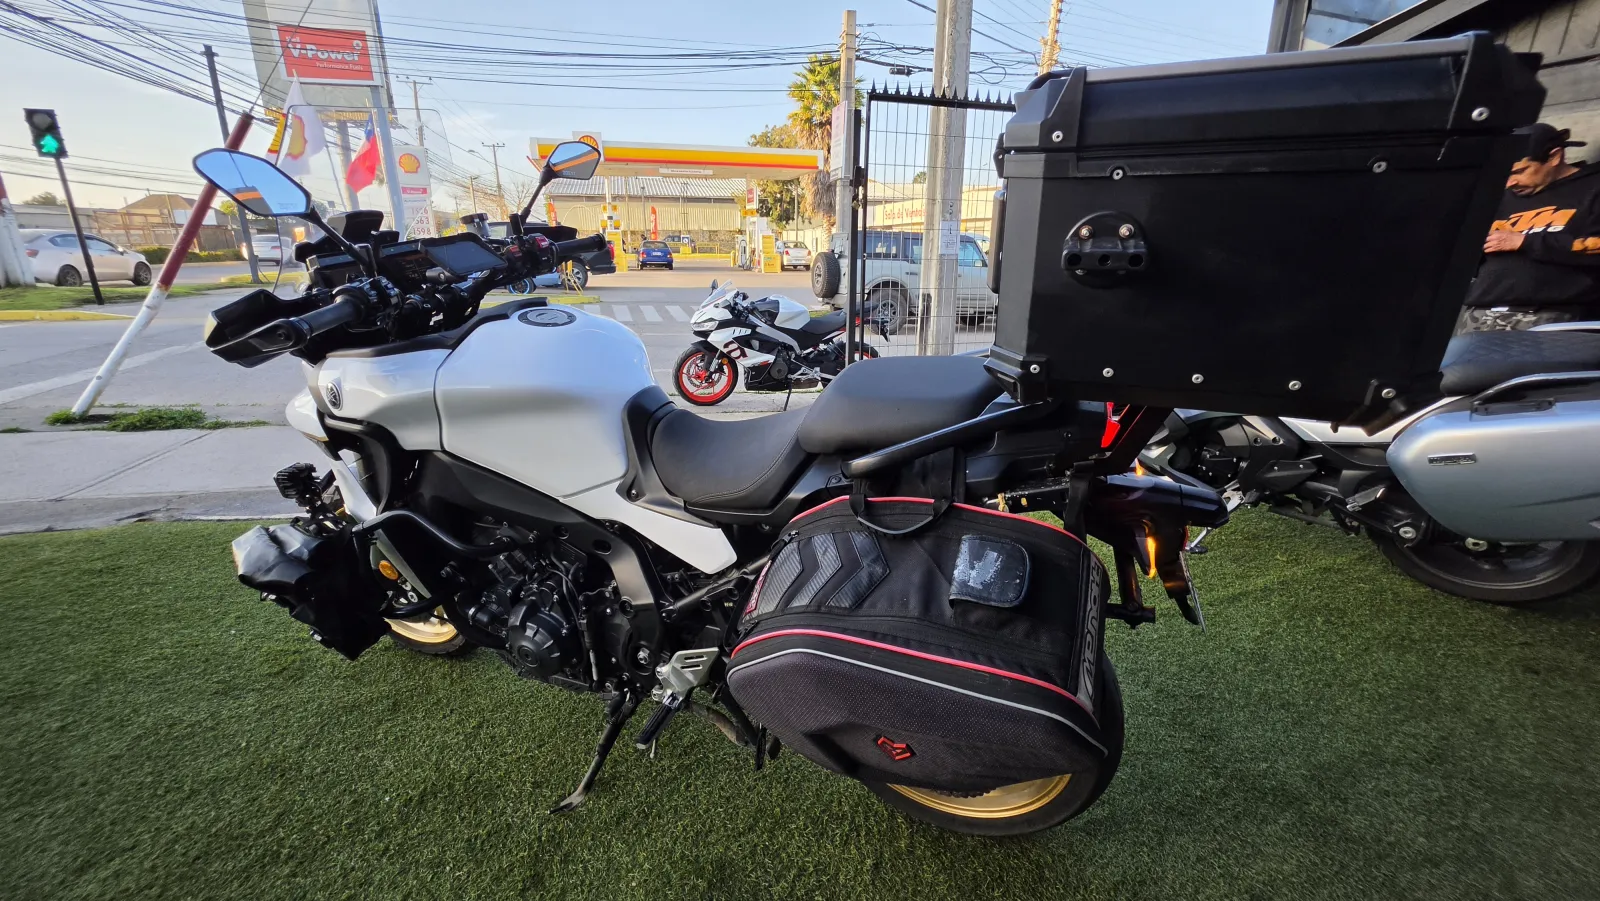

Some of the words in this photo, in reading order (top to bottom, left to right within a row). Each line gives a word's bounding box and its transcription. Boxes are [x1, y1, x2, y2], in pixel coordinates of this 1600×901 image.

[288, 43, 360, 61] V-Power
[316, 61, 349, 70] Performance
[1490, 205, 1577, 232] KTM
